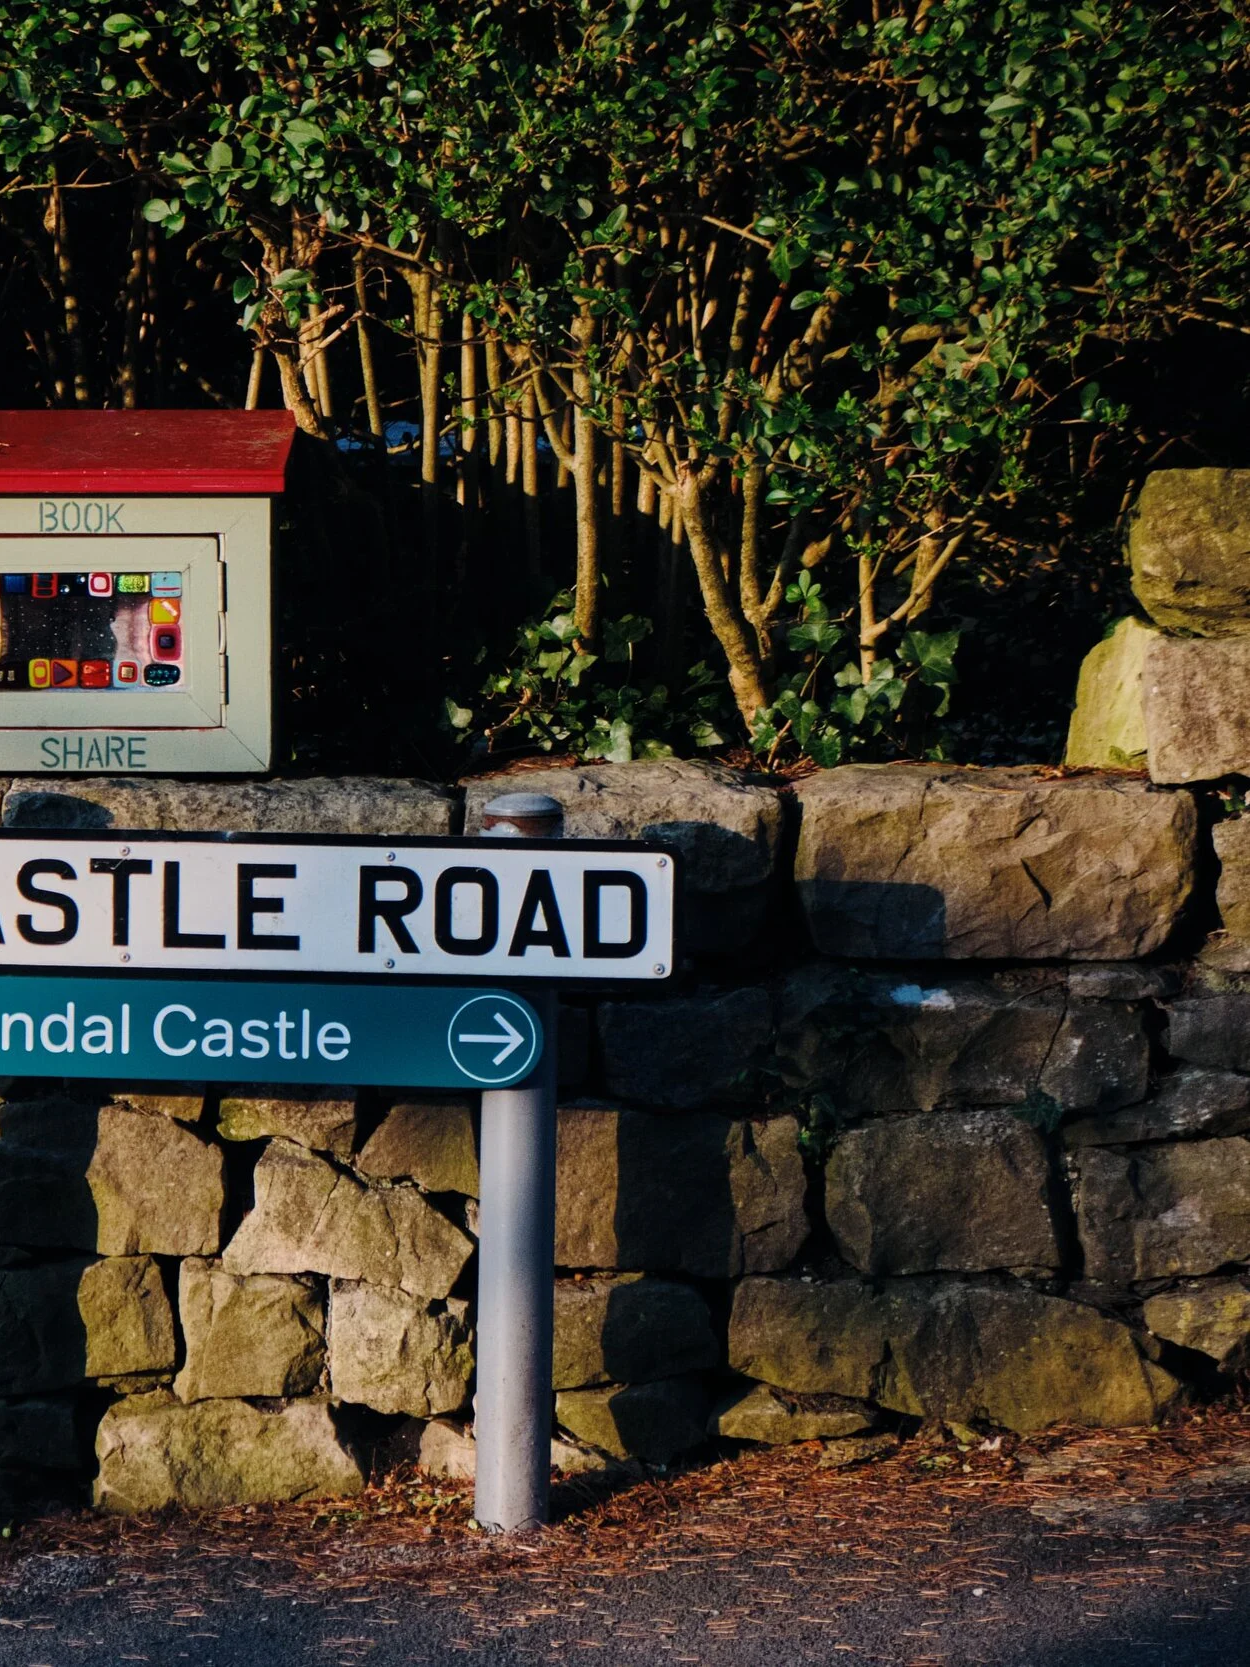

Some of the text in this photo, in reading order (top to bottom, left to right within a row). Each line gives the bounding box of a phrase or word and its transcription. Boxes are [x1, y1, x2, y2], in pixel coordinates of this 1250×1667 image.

[38, 501, 126, 534] BOOK
[40, 736, 147, 769] SHARE
[357, 864, 648, 960] ROAD
[152, 1003, 352, 1062] Castle
